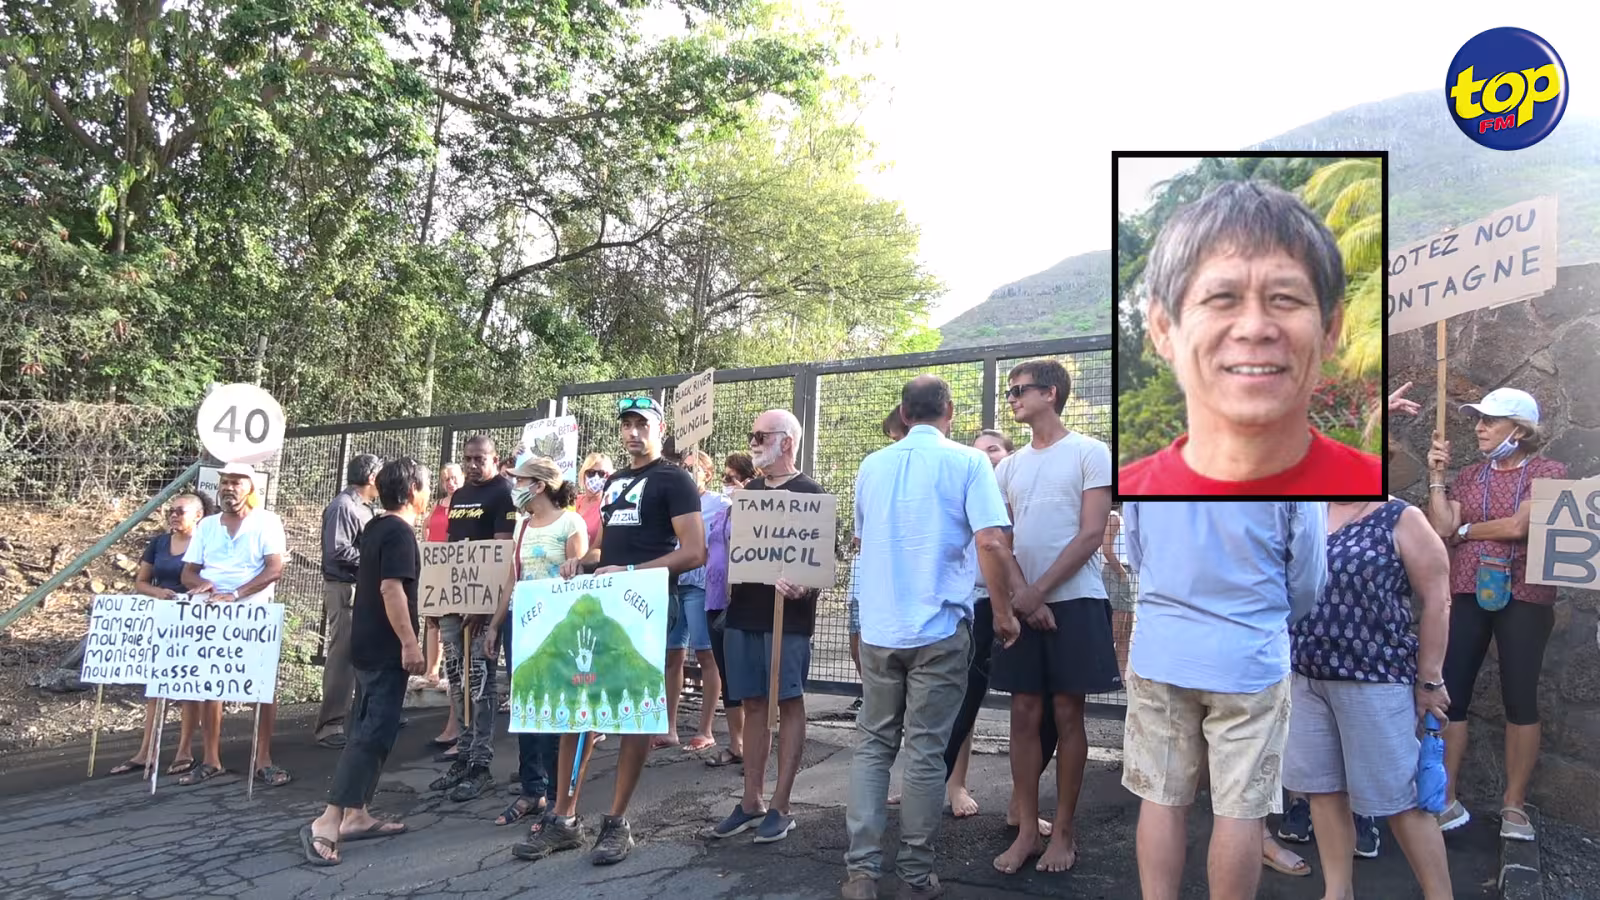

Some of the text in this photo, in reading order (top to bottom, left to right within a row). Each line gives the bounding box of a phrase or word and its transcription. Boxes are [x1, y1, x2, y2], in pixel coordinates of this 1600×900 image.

[1388, 208, 1536, 276] OTEZ NOU
[1388, 245, 1541, 319] ONTAGNE
[675, 372, 712, 403] BLACK RIVER
[680, 392, 707, 416] VILLAGE
[213, 405, 270, 444] 40
[675, 413, 710, 441] COUNCIL
[200, 481, 218, 491] PRIV
[738, 498, 821, 513] TAMARIN
[753, 525, 820, 540] VILLAGE
[423, 545, 503, 567] RESPEKTE
[730, 545, 821, 567] COUNCIL
[451, 566, 479, 583] BAN
[176, 601, 267, 621] Tamarin
[520, 602, 543, 627] KEEP
[623, 589, 655, 620] GREEN
[93, 614, 154, 632] Tamarin
[89, 633, 117, 646] nou
[157, 624, 216, 642] village
[85, 646, 152, 664] montagn
[166, 642, 189, 658] dir
[197, 646, 243, 659] arete
[151, 663, 245, 679] kasse nou
[158, 679, 253, 697] montagne
